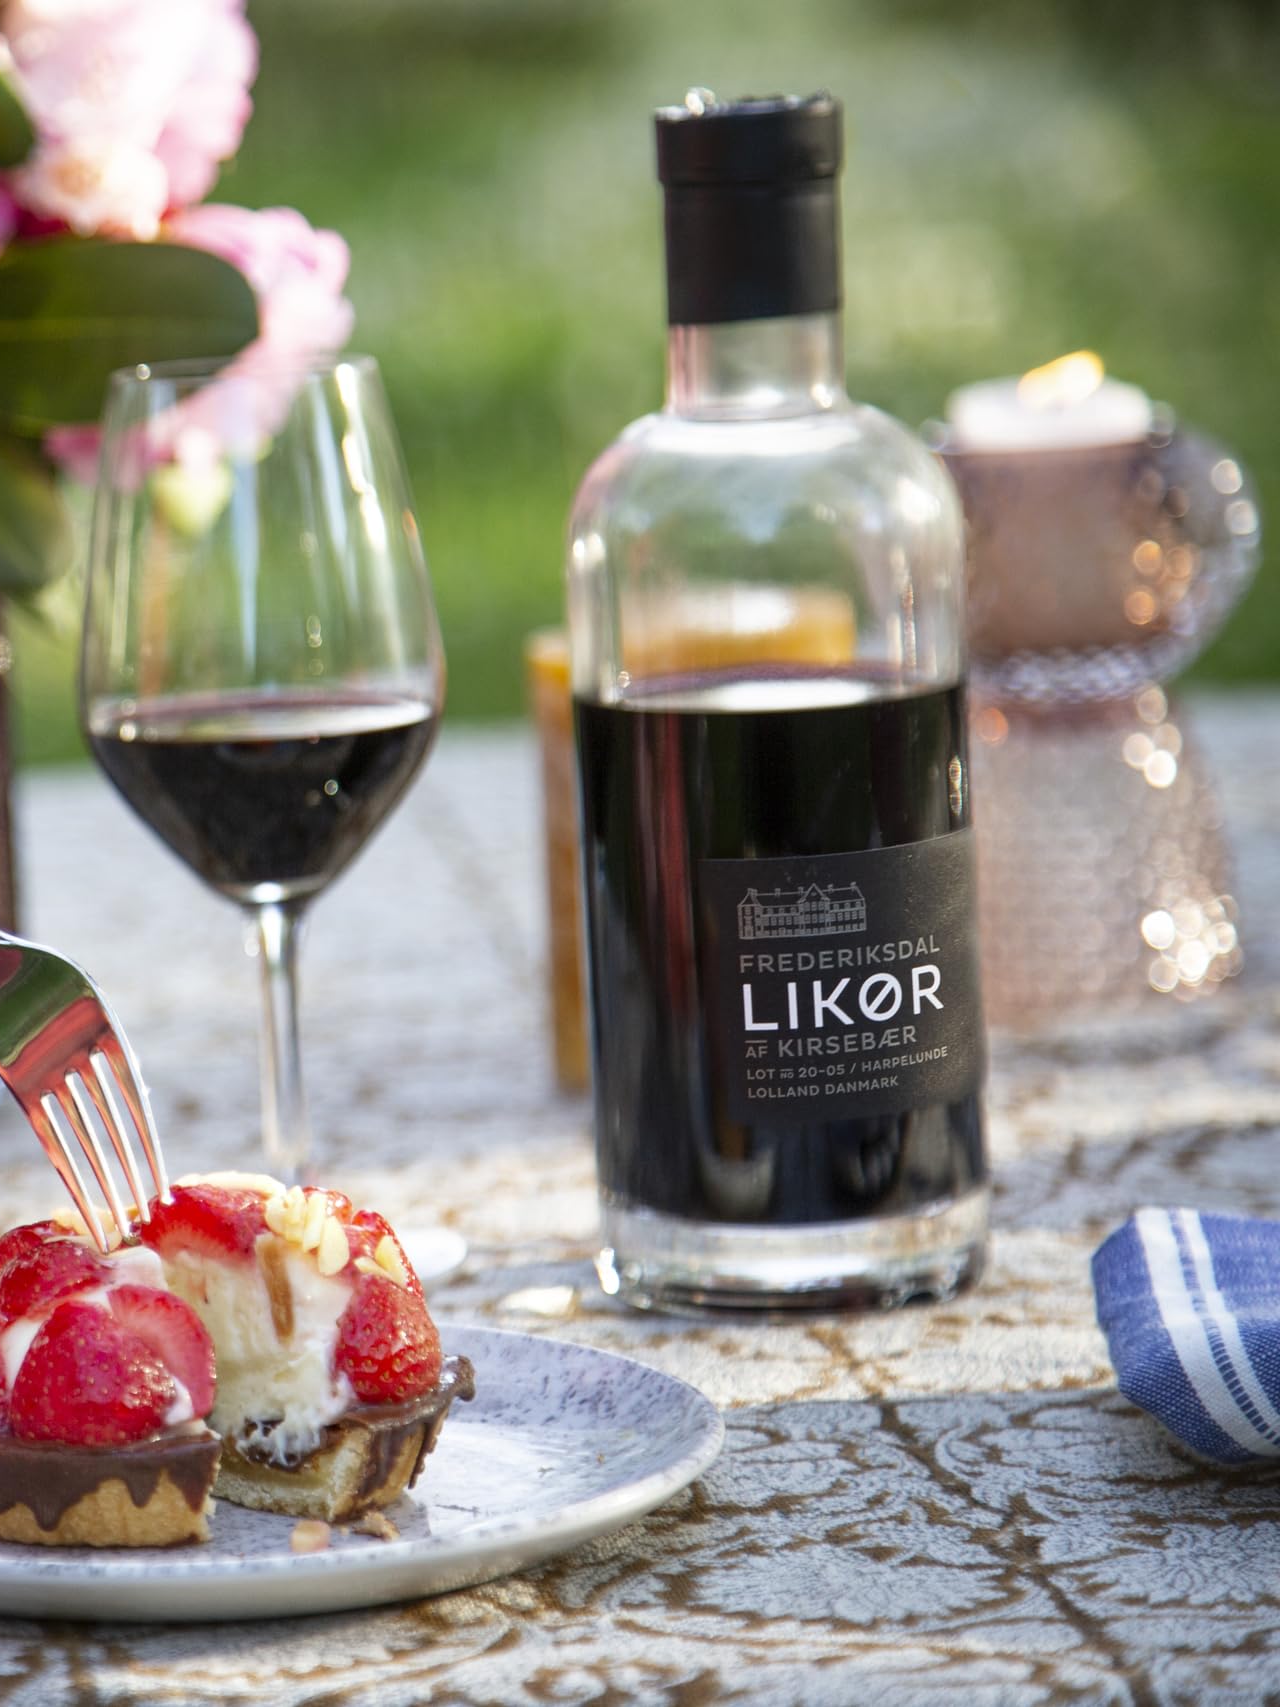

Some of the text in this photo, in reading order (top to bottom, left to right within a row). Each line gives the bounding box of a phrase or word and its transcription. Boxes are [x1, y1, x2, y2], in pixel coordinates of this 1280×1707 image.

[739, 934, 941, 974] FREDERIKSDAL
[742, 964, 945, 1031] LIKØR
[745, 1025, 917, 1059] AF KIRSEBÆR
[746, 1068, 776, 1081] LOT
[798, 1063, 846, 1079] 20-05
[861, 1046, 949, 1073] HARPELUNDE
[747, 1075, 899, 1099] LOLLAND DANMARK
